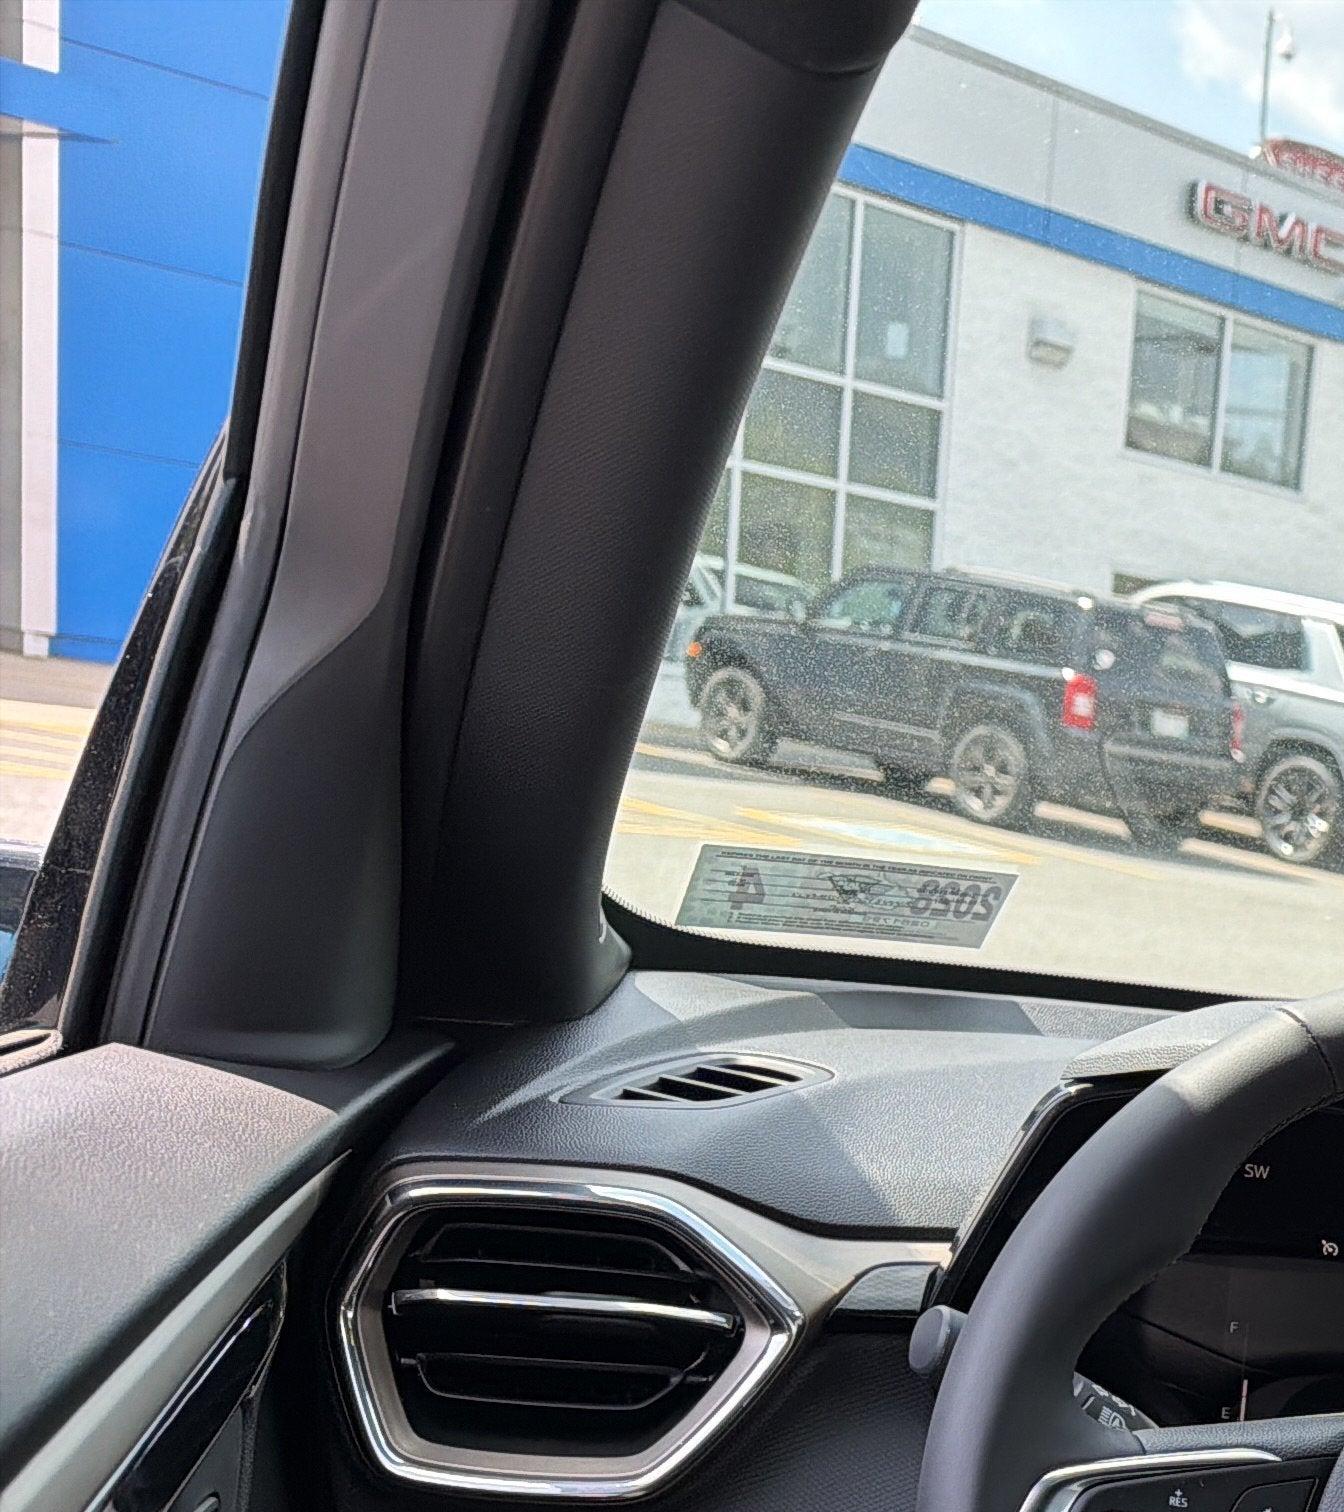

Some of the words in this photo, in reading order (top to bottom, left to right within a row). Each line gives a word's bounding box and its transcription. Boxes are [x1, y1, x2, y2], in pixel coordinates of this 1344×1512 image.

[1244, 1163, 1271, 1180] SW
[1230, 1321, 1239, 1333] F
[1221, 1407, 1231, 1420] E
[1168, 1496, 1188, 1508] RES
